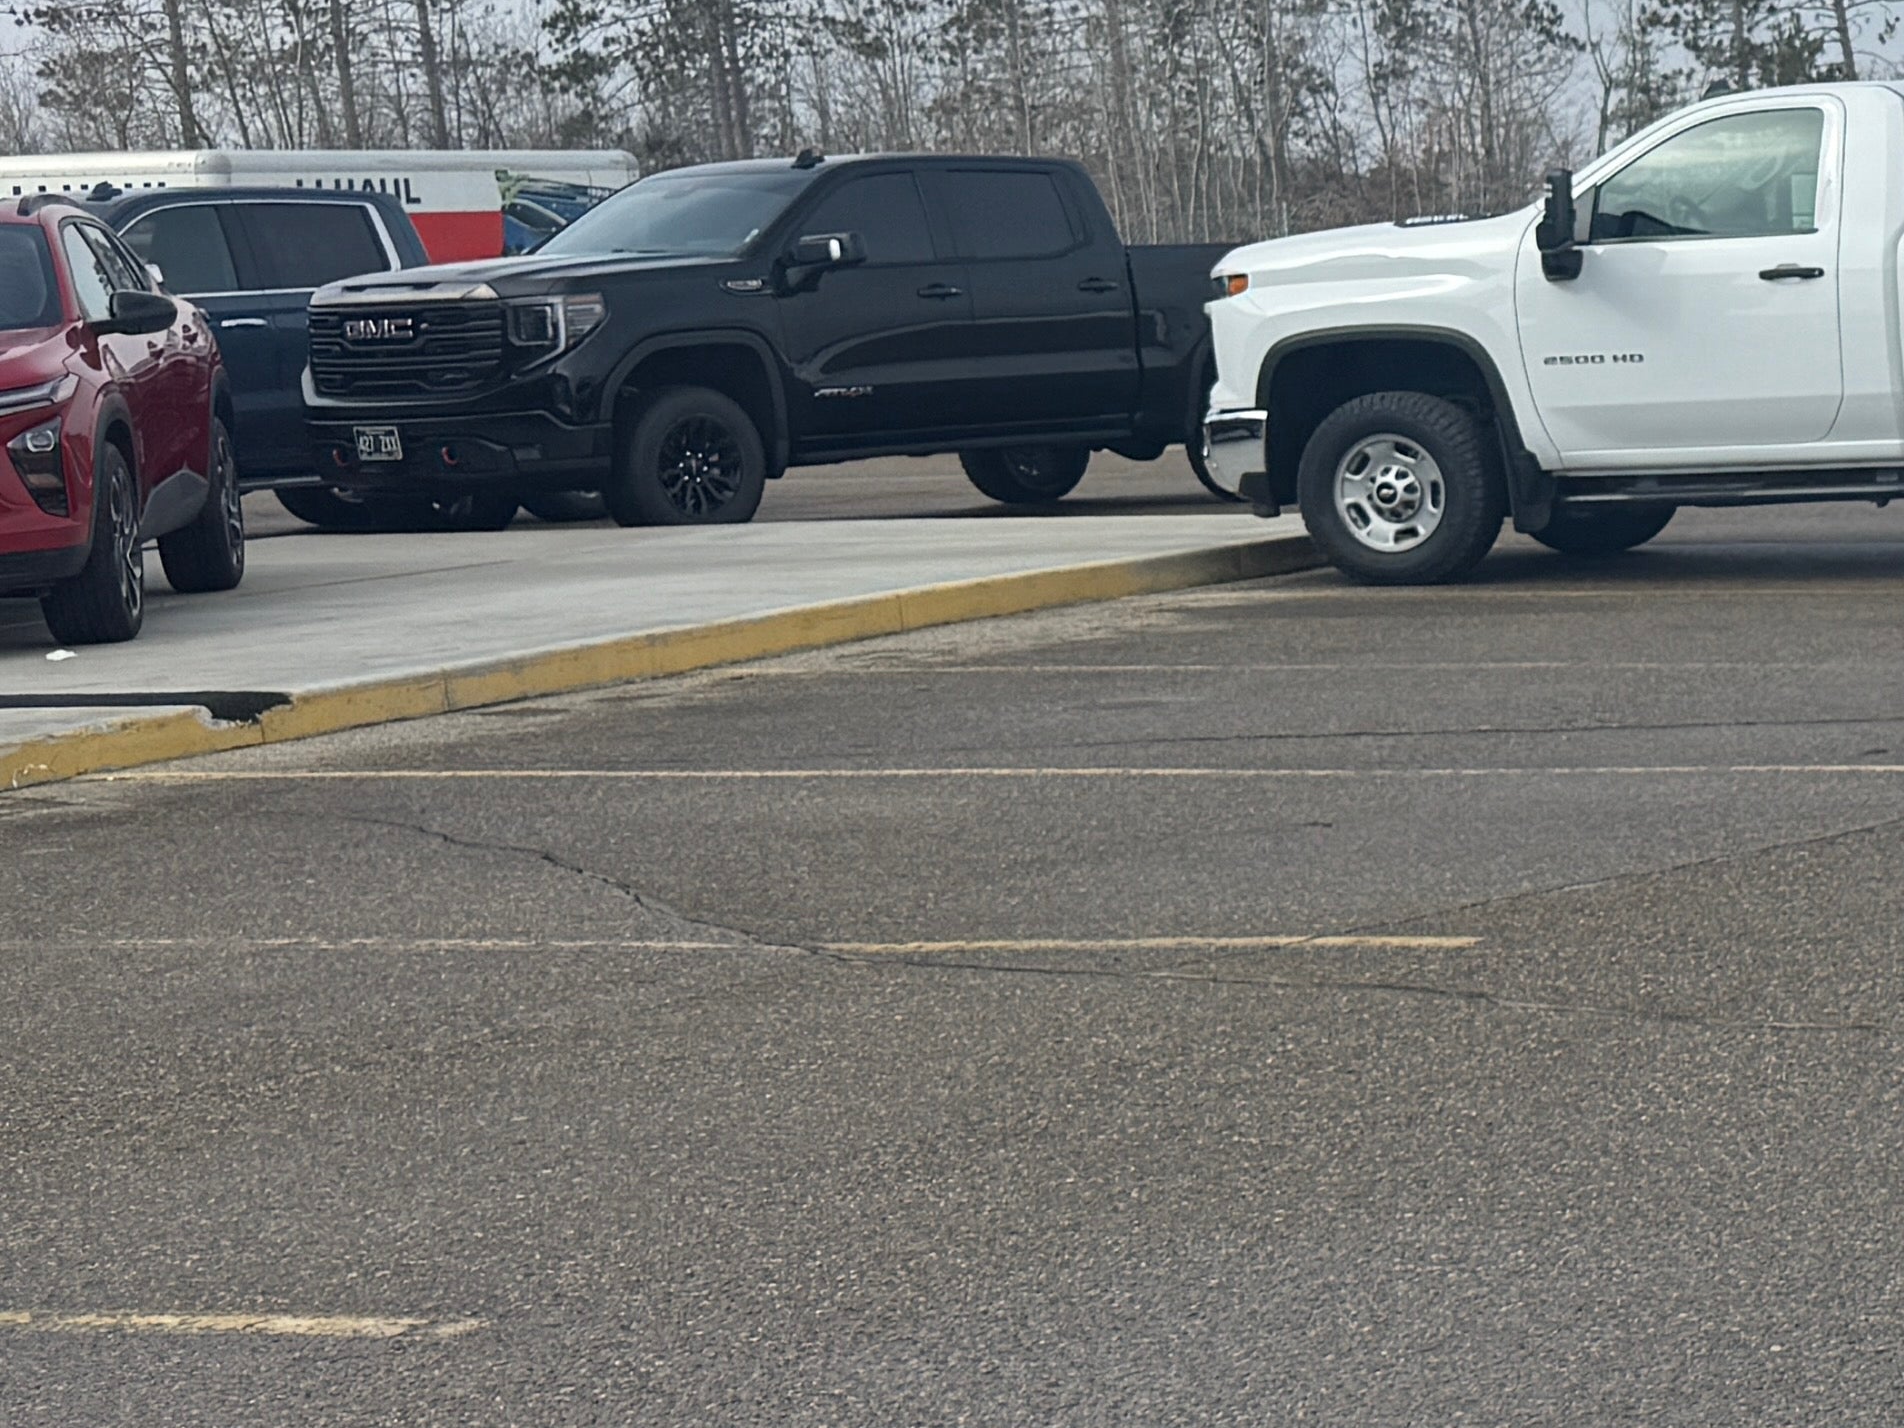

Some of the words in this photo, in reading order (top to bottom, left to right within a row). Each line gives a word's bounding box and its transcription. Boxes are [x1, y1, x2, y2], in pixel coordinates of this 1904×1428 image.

[343, 318, 414, 340] GMC
[1543, 355, 1605, 366] 2500
[1612, 353, 1644, 364] HD
